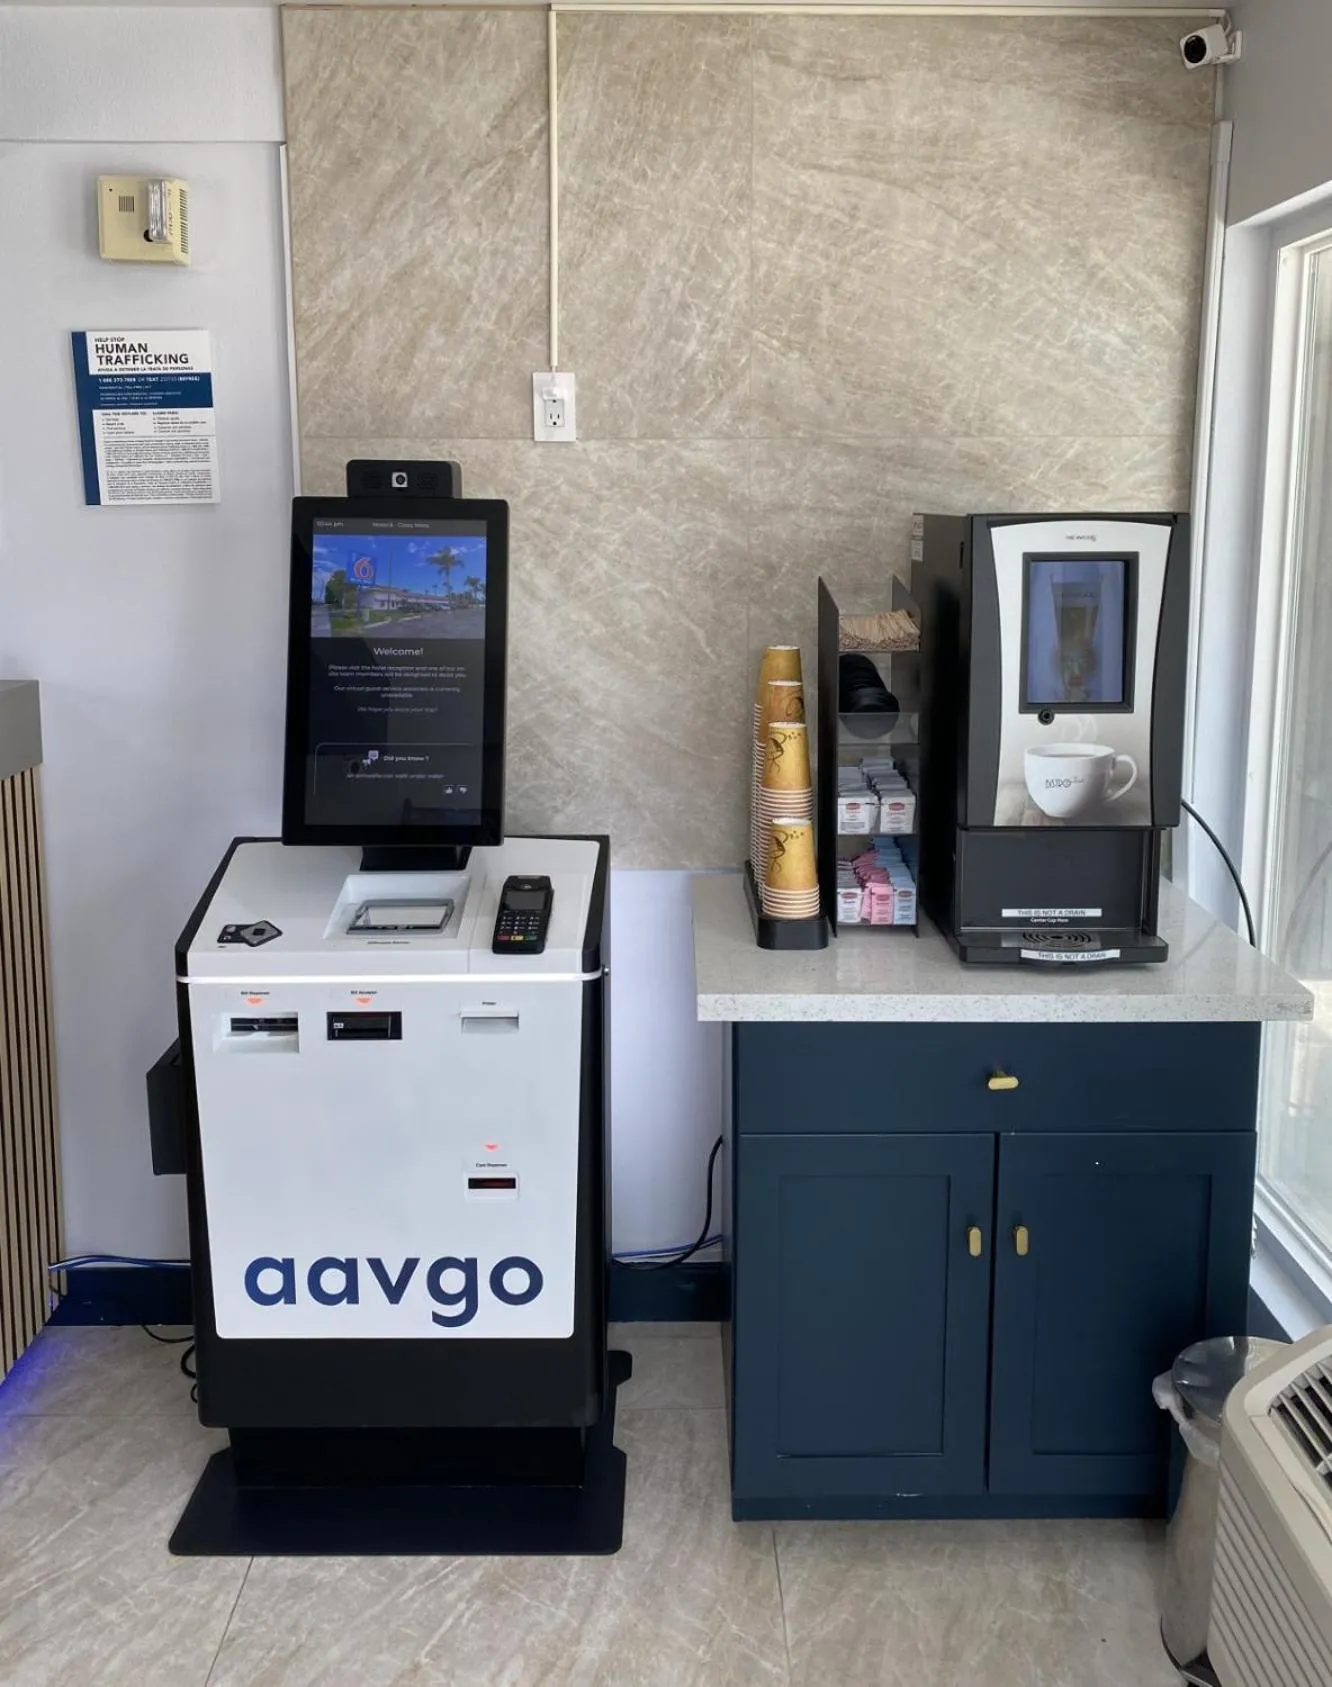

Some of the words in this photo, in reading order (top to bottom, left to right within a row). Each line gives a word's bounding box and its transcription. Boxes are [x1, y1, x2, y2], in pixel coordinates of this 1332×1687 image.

[95, 343, 148, 354] HUMAN
[97, 354, 189, 366] TRAFFICKING
[373, 647, 424, 656] Welcome!
[244, 1256, 544, 1328] aavgo
